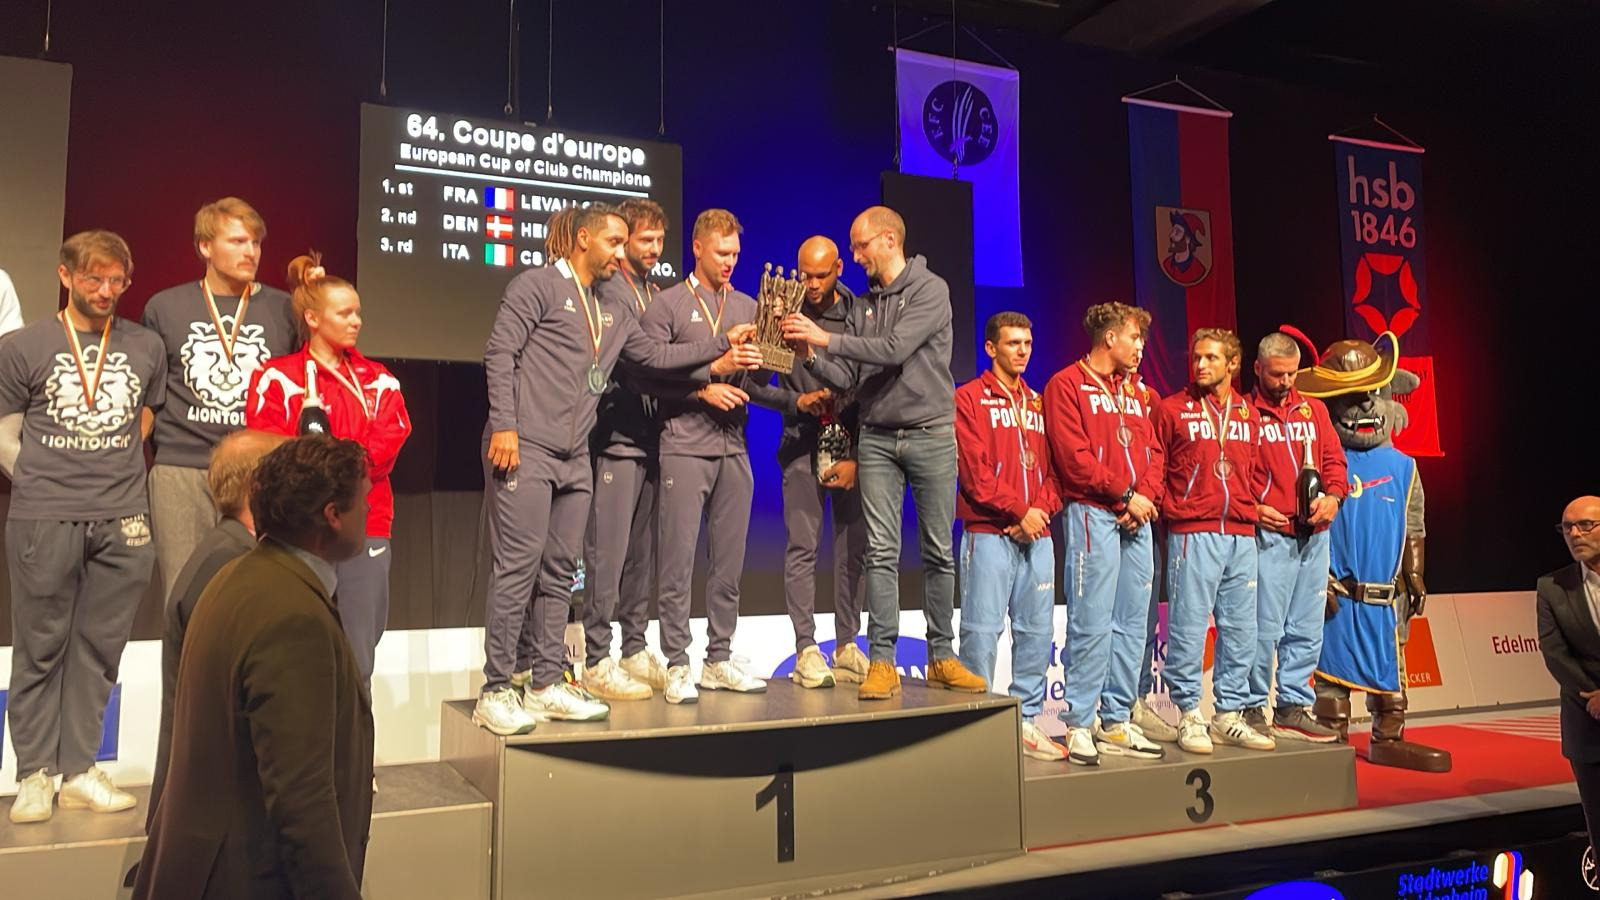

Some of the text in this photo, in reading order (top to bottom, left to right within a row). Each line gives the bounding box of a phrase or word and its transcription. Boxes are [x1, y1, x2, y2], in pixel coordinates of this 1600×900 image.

[406, 113, 646, 168] 64. Coupe d'europe
[400, 142, 651, 187] European Cup of Club Champions
[1347, 154, 1415, 211] hsb
[382, 178, 395, 194] 1.
[398, 182, 414, 196] st
[443, 185, 478, 205] FRA
[381, 207, 394, 223] 2.
[397, 210, 417, 225] nd
[443, 214, 478, 233] DEN
[1350, 209, 1416, 248] 1846
[380, 237, 394, 253] 3.
[397, 239, 413, 254] rd
[442, 242, 470, 261] ITA
[1187, 420, 1251, 442] POLZIA
[1492, 634, 1541, 654] Edelm
[755, 764, 795, 864] 1
[1185, 768, 1215, 824] 3
[1398, 860, 1489, 896] Stadtwerke
